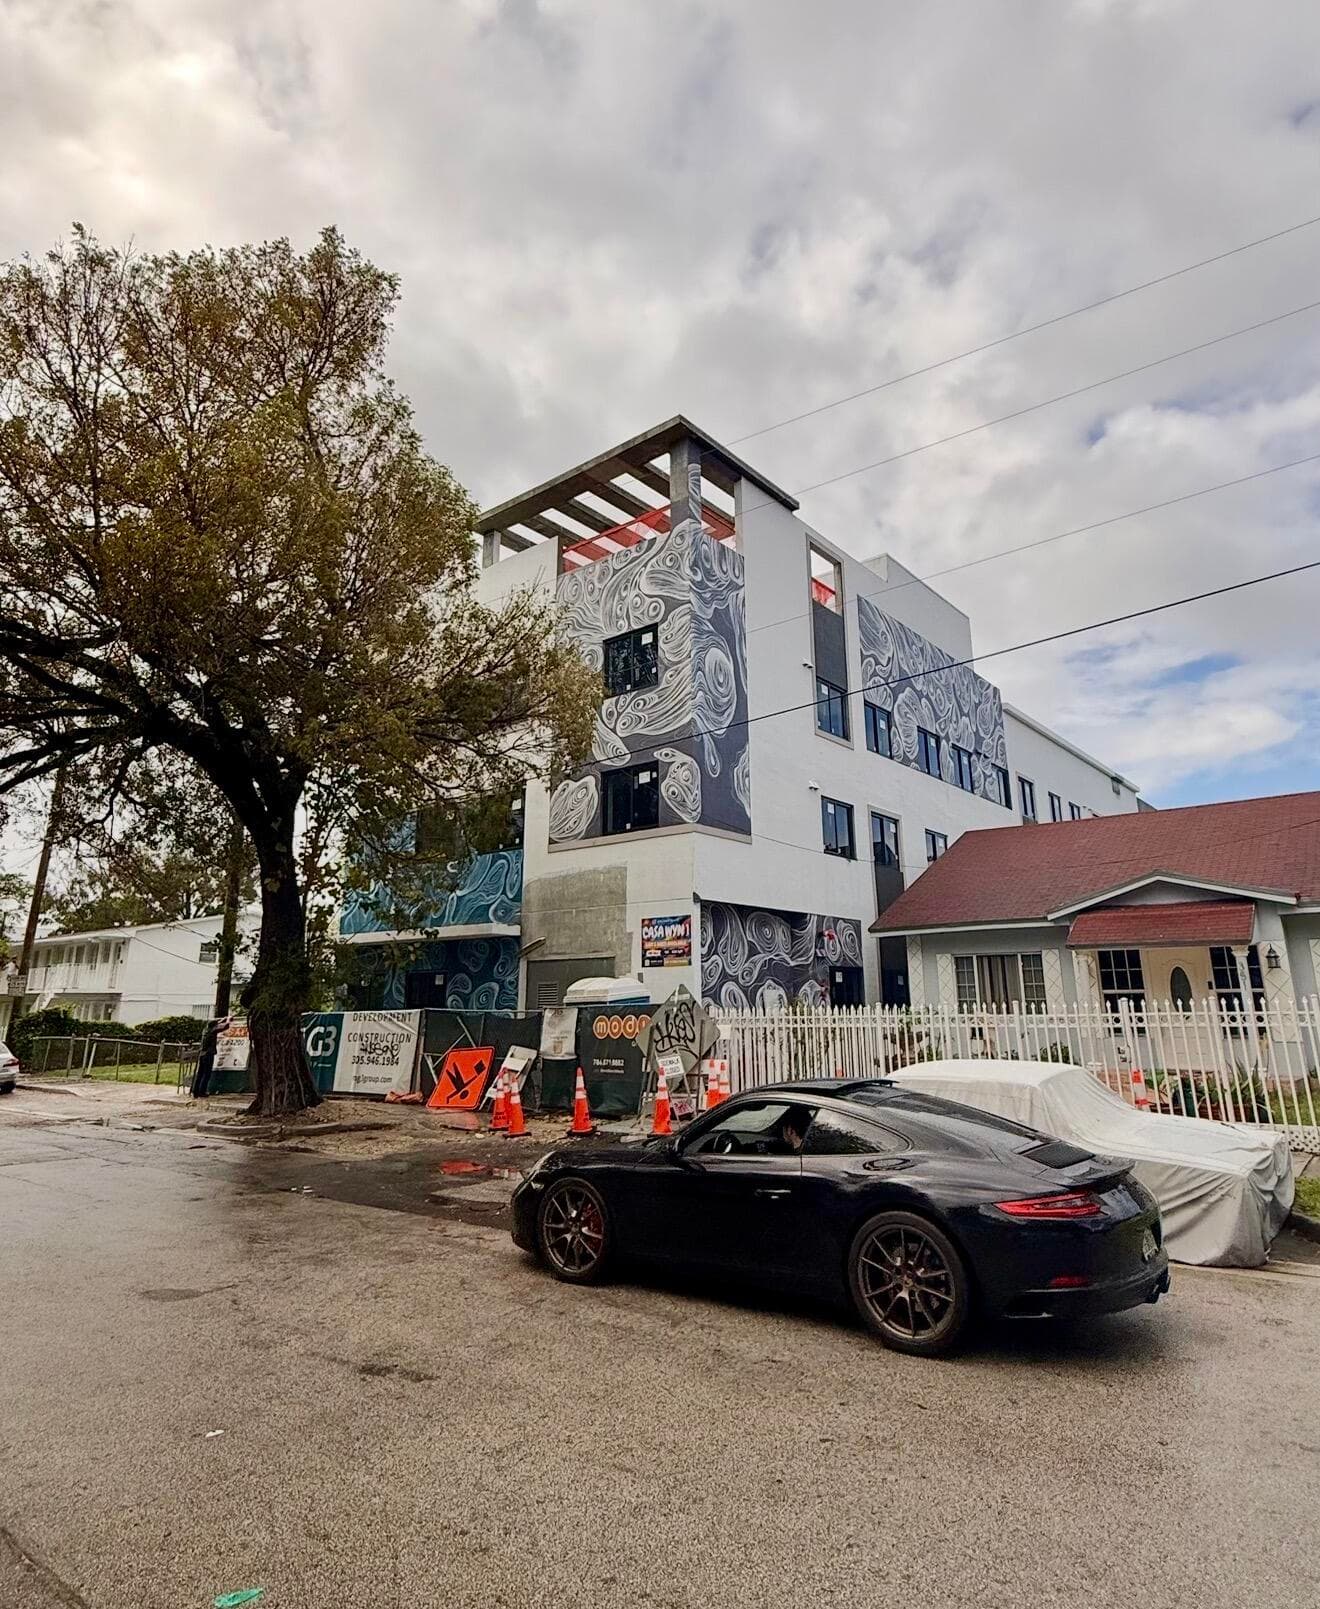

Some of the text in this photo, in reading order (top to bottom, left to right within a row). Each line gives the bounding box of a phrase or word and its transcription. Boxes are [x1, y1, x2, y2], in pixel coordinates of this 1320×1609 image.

[642, 924, 665, 940] CASA
[665, 923, 685, 938] WYN
[352, 1012, 412, 1022] DEVELOPMENT
[347, 1032, 412, 1043] CONSTRUCTION
